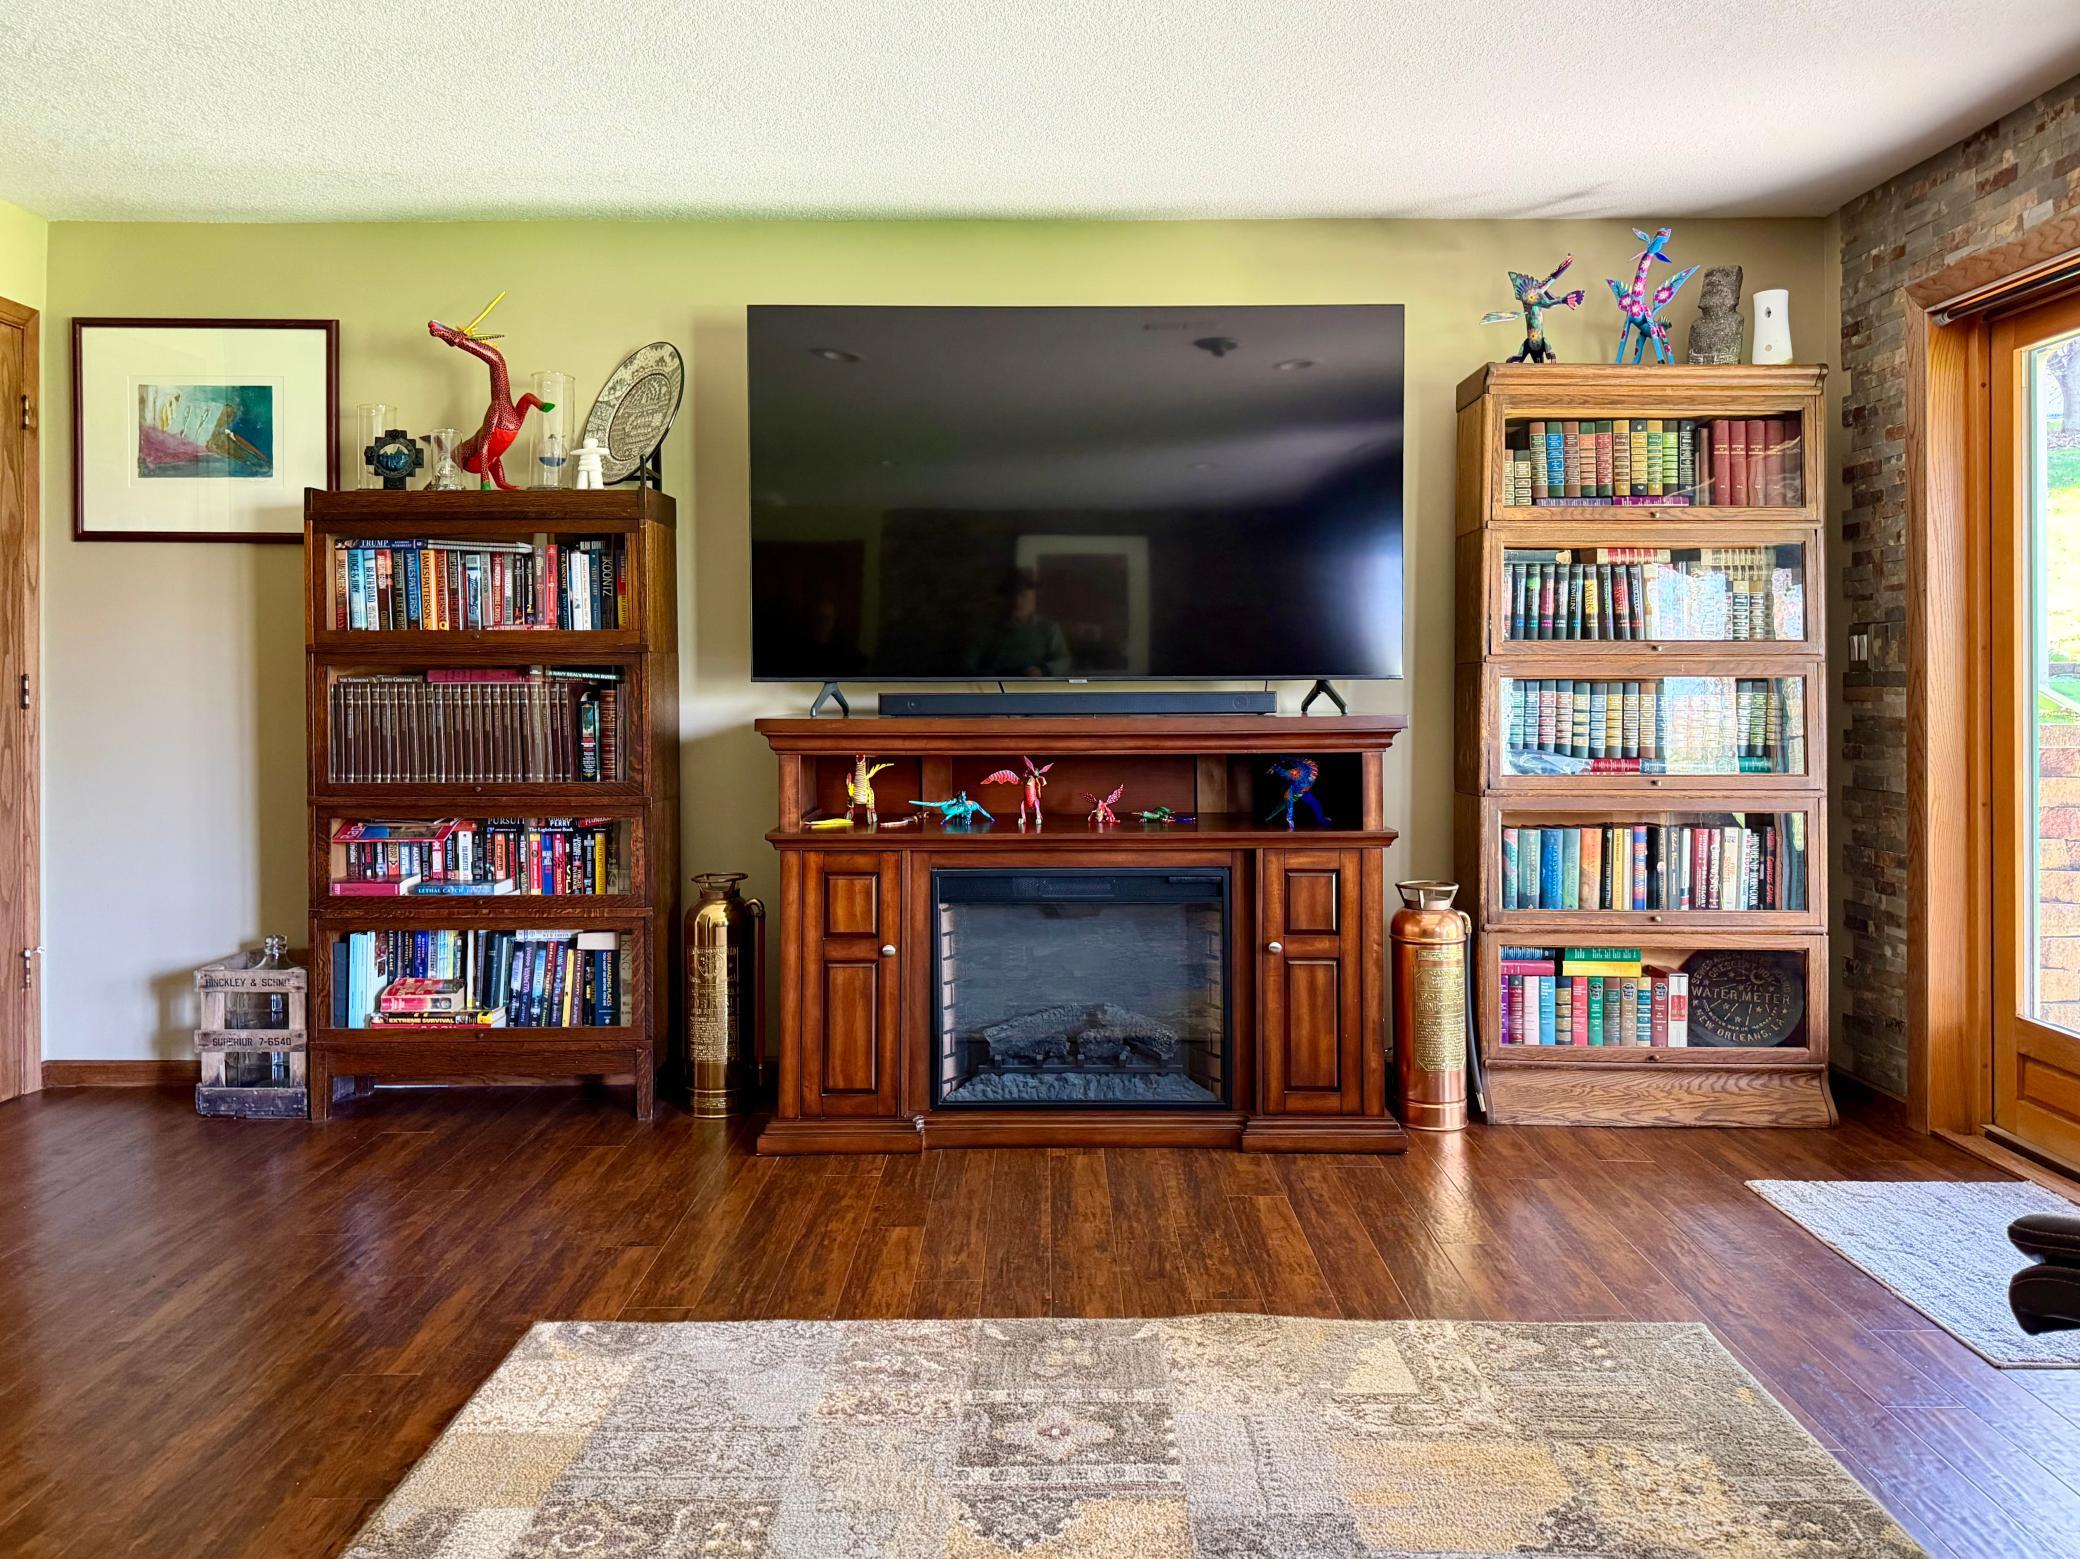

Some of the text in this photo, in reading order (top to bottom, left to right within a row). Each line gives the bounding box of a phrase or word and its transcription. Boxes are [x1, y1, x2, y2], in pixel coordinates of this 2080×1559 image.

[351, 580, 360, 593] JURY
[366, 566, 376, 603] BEACH ROAD
[406, 553, 419, 620] JAMES PATTERSON
[421, 552, 432, 619] JAMES PATTERSON
[437, 553, 447, 620] JAMES PATTERSON
[602, 559, 613, 597] KOONTZ
[1584, 584, 1594, 609] MARK
[494, 605, 502, 621] CROSS
[487, 815, 525, 825] PURSUIT
[549, 819, 572, 827] PERRY
[422, 862, 430, 877] COOK
[1749, 889, 1759, 906] COOK
[622, 940, 632, 971] KING
[205, 978, 246, 988] HINCKLEY
[250, 978, 257, 987] &
[1691, 985, 1791, 1005] WATER METER
[1696, 1008, 1715, 1030] NEW
[212, 1037, 292, 1047] SUPERIOR 7-6540
